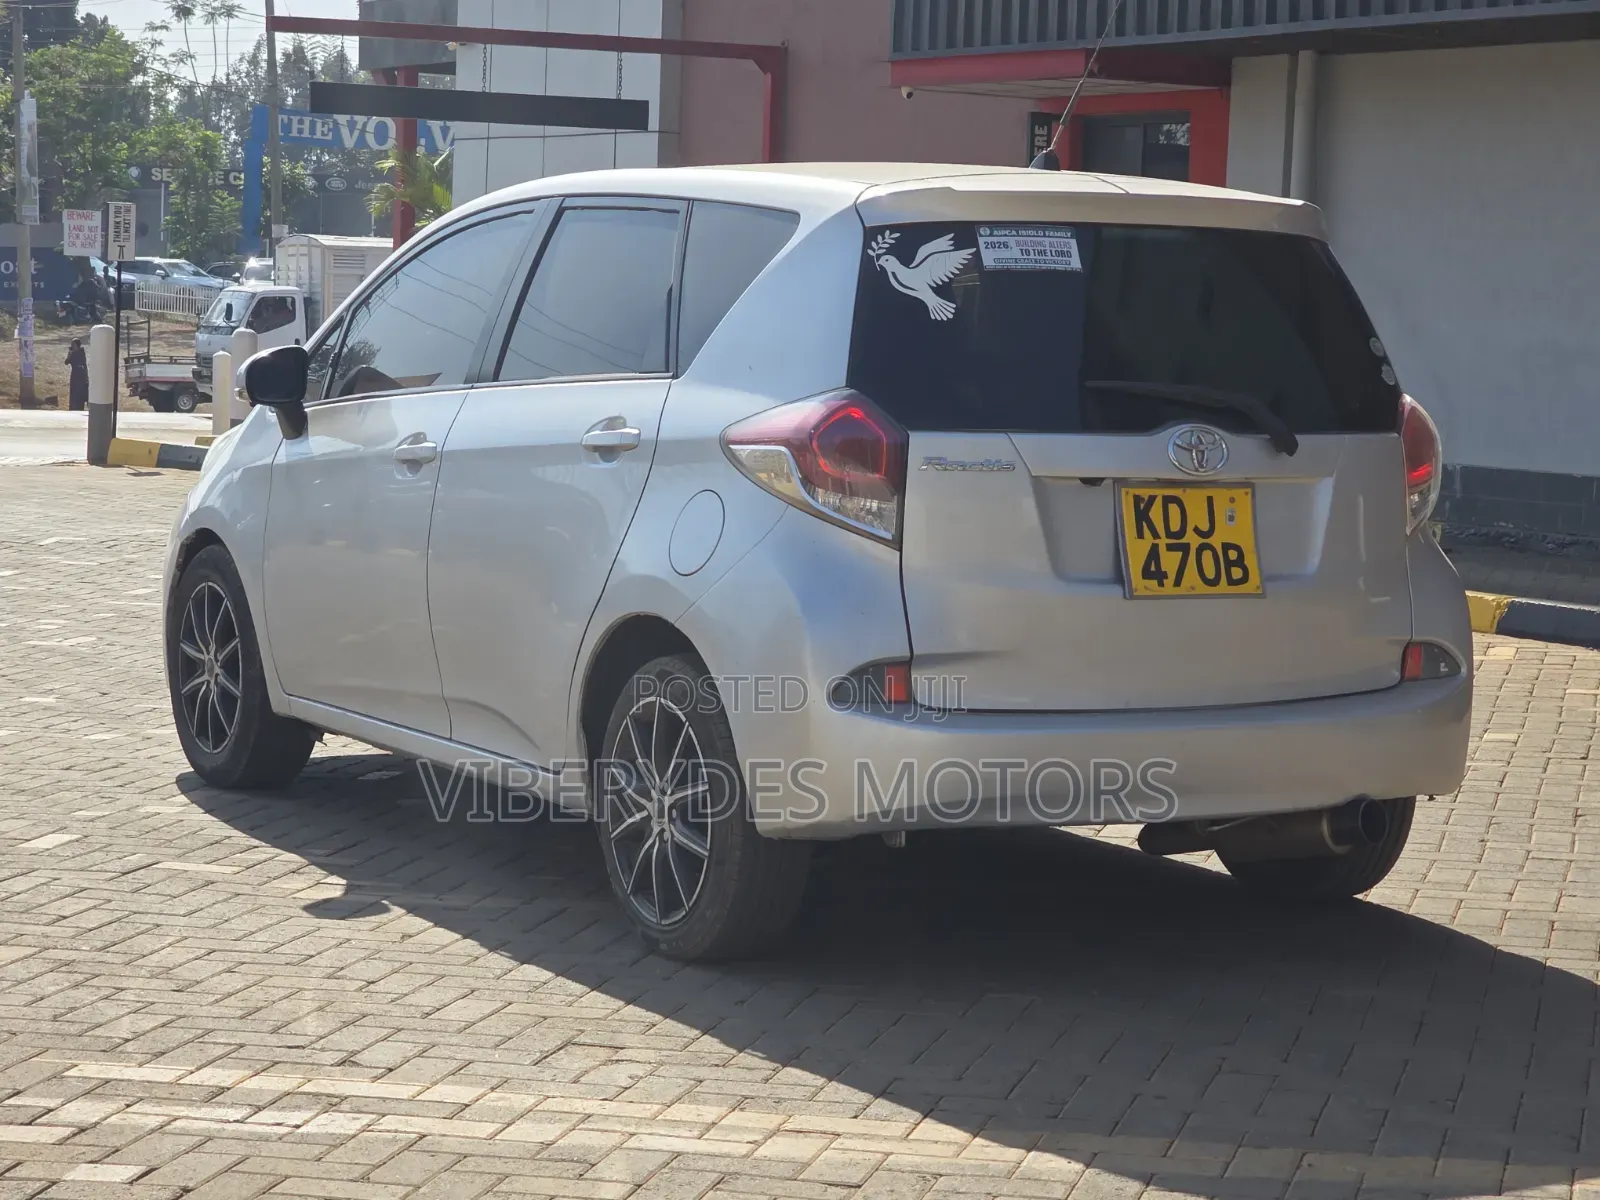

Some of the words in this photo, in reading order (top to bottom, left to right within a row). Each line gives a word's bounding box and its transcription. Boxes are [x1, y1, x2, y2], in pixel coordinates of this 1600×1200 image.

[278, 114, 332, 140] THE
[333, 114, 455, 154] VOV
[67, 211, 95, 221] BEWARE
[114, 205, 122, 219] YOU
[123, 205, 132, 217] TIME
[68, 224, 85, 232] LAND
[88, 225, 98, 233] NOT
[113, 220, 122, 242] THANK
[123, 218, 131, 234] NEXT
[83, 233, 98, 241] SALE
[81, 241, 96, 249] RENT
[1015, 240, 1046, 249] BUILDING
[1049, 240, 1072, 249] ALTERS
[1019, 248, 1030, 256] TO
[1032, 249, 1048, 257] THE
[1050, 249, 1072, 258] LORD
[1132, 494, 1216, 540] KDJ
[1141, 542, 1249, 587] 470B
